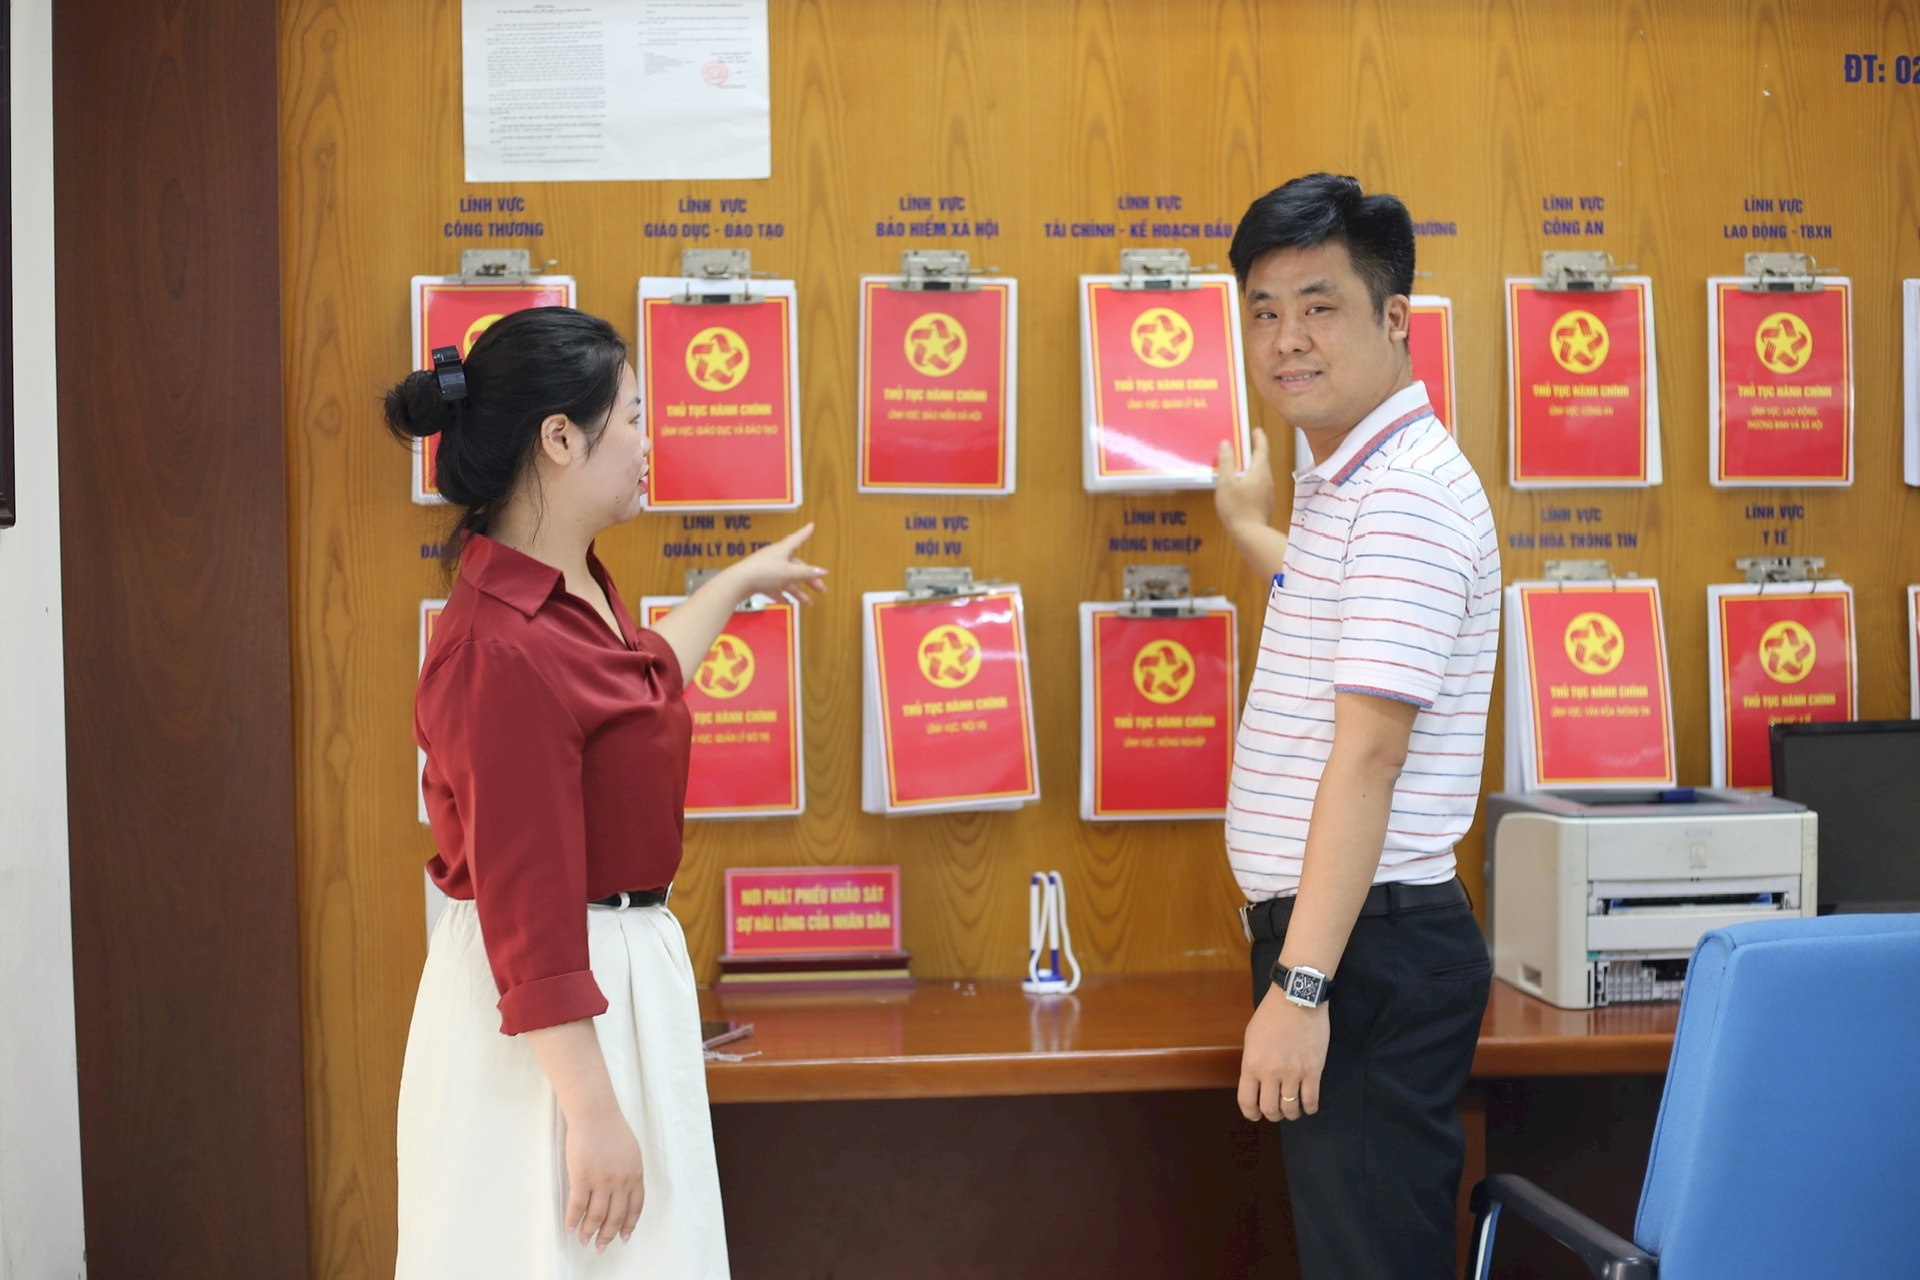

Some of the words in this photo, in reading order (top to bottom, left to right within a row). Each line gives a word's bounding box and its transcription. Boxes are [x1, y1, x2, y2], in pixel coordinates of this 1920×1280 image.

[1844, 54, 1885, 83] ĐT:
[460, 195, 492, 212] LĨNH
[498, 197, 524, 216] VỰC
[679, 195, 711, 213] LĨNH
[720, 198, 746, 217] VỰC
[899, 194, 932, 211] LĨNH
[938, 196, 966, 215] VỰC
[1118, 193, 1150, 210] LĨNH
[1156, 196, 1182, 214] VỰC
[1543, 195, 1573, 211] LĨNH
[1579, 196, 1605, 214] VỰC
[1744, 195, 1773, 212] LĨNH
[1779, 198, 1803, 216] VỰC
[444, 220, 483, 237] CÔNG
[489, 221, 544, 236] THƯƠNG
[644, 220, 677, 237] GIÁO
[682, 223, 710, 241] DỤC
[758, 223, 784, 240] TẠO
[876, 216, 905, 236] BẢO
[975, 218, 999, 239] HỘI
[1071, 219, 1115, 237] CHÍNH
[1130, 217, 1148, 237] KẾ
[1152, 223, 1200, 242] HOẠCH
[1543, 217, 1580, 235] CÔNG
[1584, 220, 1604, 235] AN
[1724, 225, 1748, 238] LAO
[1752, 221, 1787, 242] ĐỘNG
[1800, 225, 1832, 239] TBXH
[905, 512, 937, 530] LĨNH
[942, 516, 969, 533] VỰC
[1541, 505, 1571, 522] LĨNH
[1577, 507, 1602, 526] VỰC
[1745, 501, 1774, 519] LĨNH
[1780, 504, 1804, 523] VỰC
[724, 515, 751, 532] VỰC
[663, 537, 703, 558] QUẢN
[707, 539, 722, 556] LÝ
[915, 538, 939, 558] NỘI
[944, 541, 962, 558] VỤ
[1109, 533, 1147, 552] NÔNG
[1570, 531, 1612, 548] THÔNG
[1617, 533, 1637, 547] TIN
[1763, 531, 1770, 545] Y
